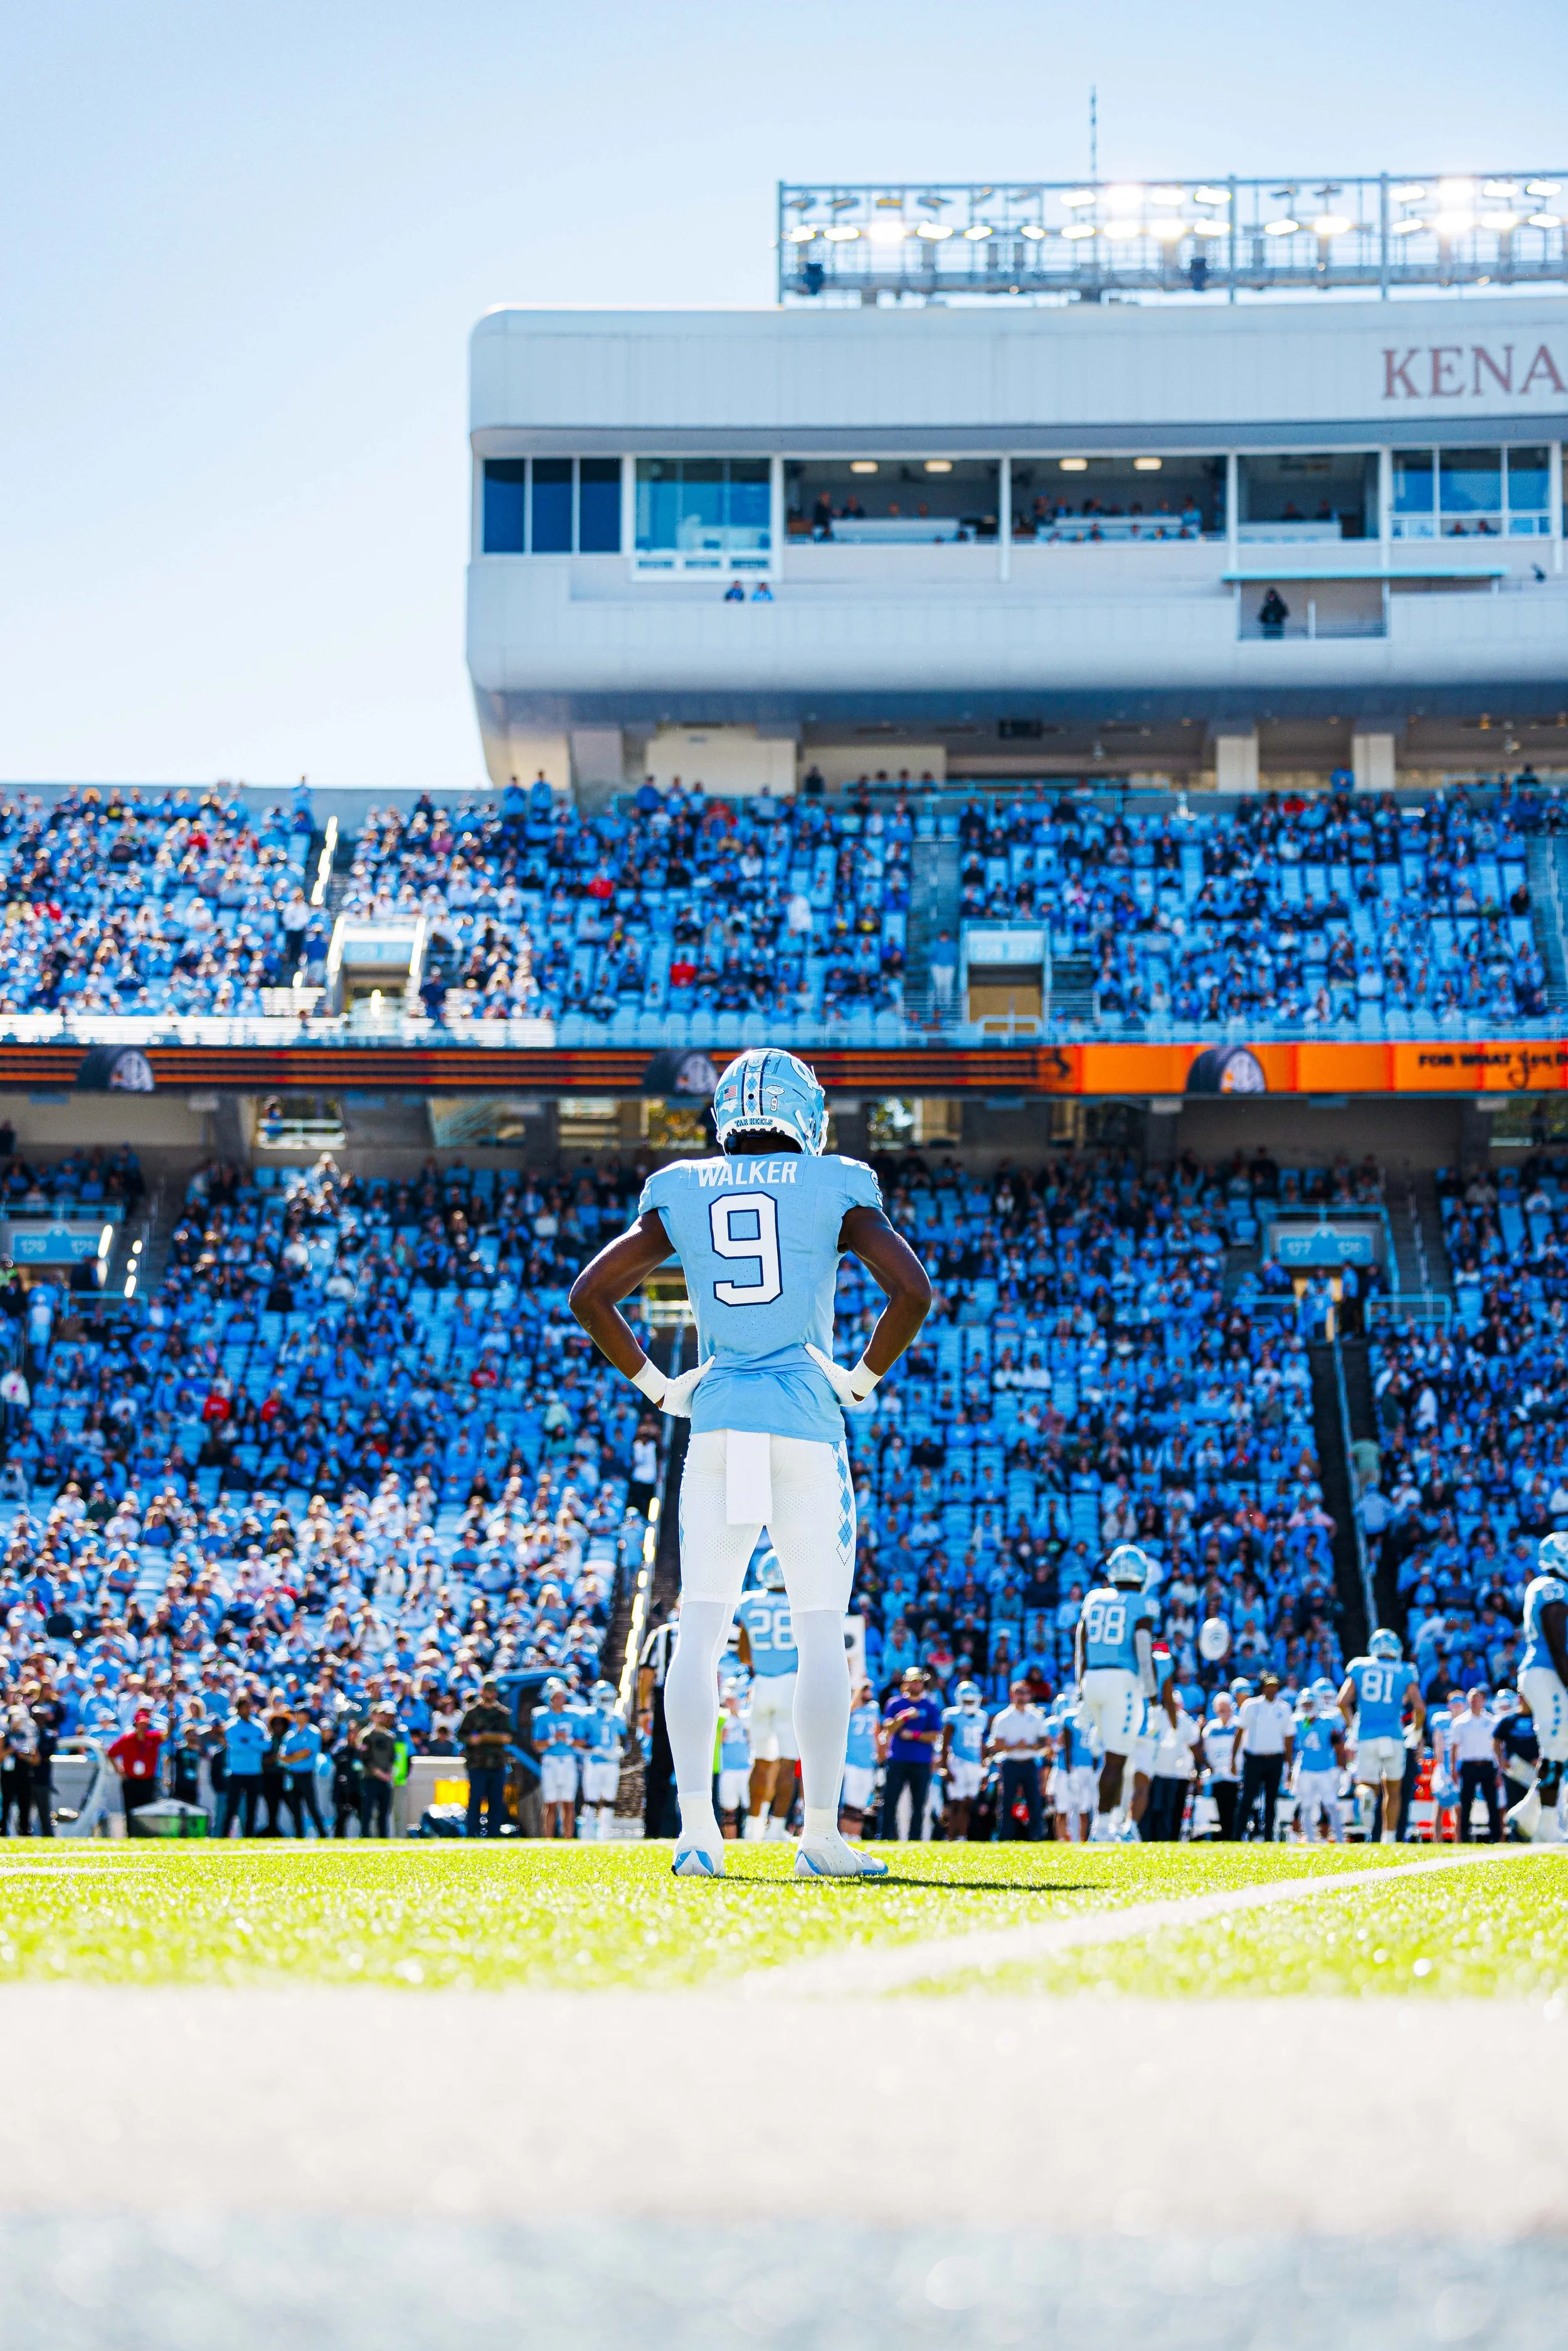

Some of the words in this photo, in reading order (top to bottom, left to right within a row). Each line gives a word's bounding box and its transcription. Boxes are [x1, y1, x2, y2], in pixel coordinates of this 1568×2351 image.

[1382, 344, 1568, 399] KENA
[734, 1119, 748, 1127] TAR
[749, 1118, 773, 1126] HEELS
[770, 1098, 778, 1112] 9
[697, 1161, 798, 1187] WALKER
[708, 1191, 783, 1307] 9
[1086, 1602, 1126, 1646] 88
[1361, 1669, 1394, 1704] 81
